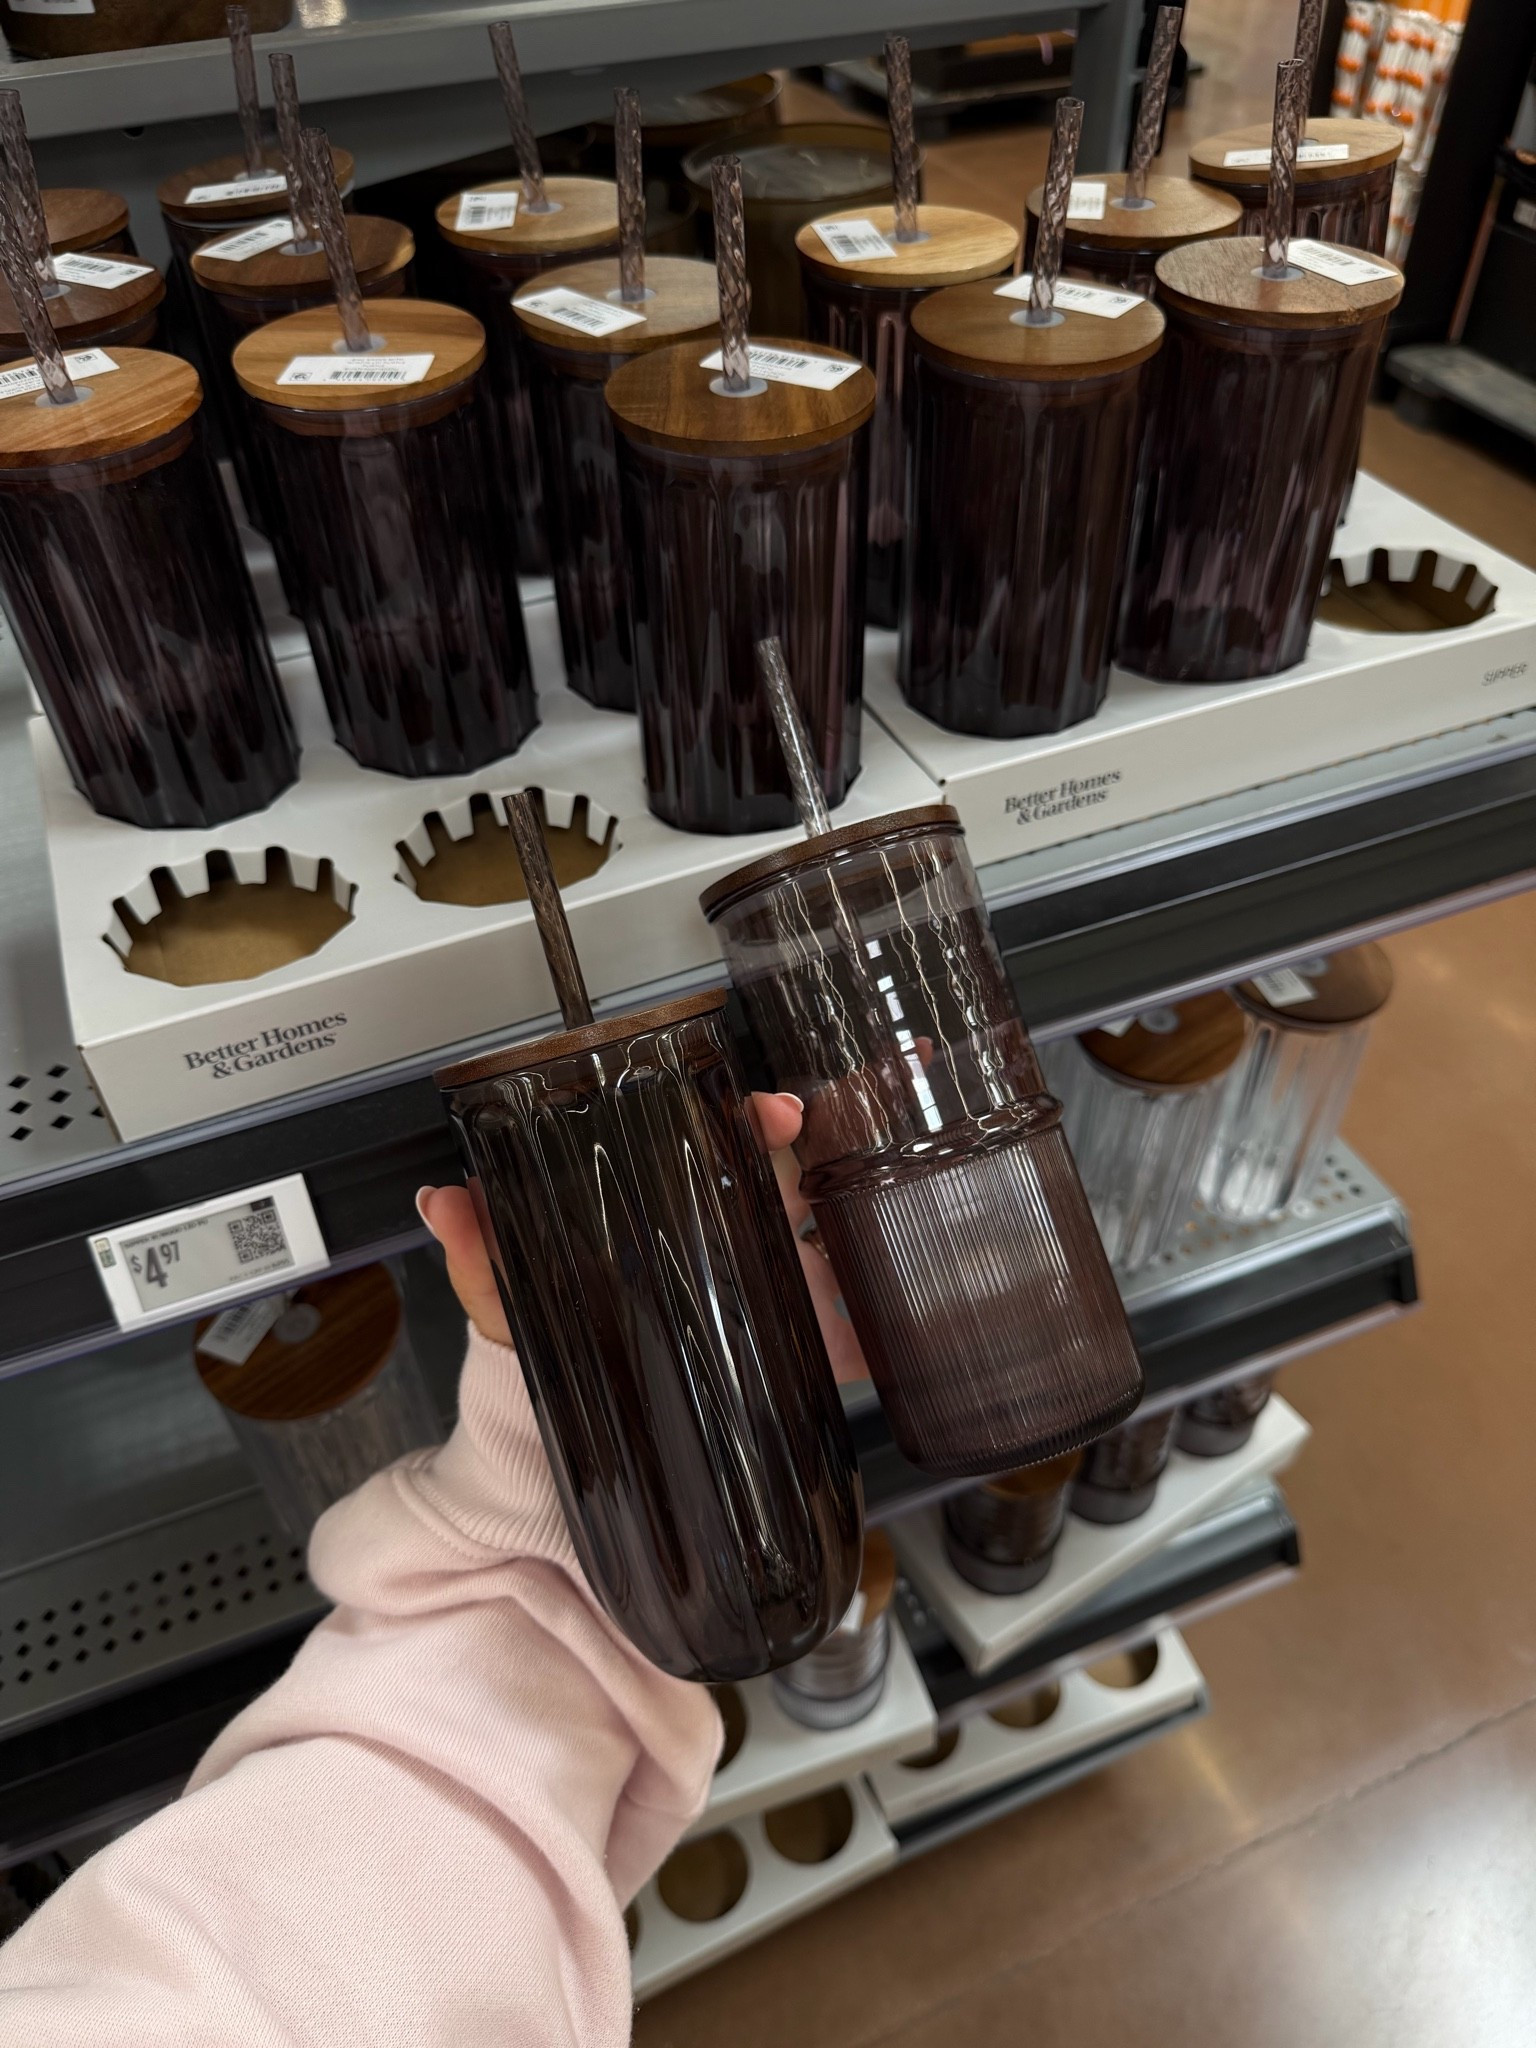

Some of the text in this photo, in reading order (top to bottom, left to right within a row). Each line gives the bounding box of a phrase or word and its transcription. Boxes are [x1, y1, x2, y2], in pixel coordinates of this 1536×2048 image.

[1004, 771, 1121, 813] Better Homes
[1033, 790, 1108, 820] Gardens
[184, 1012, 348, 1070] Better Homes
[234, 1033, 336, 1072] Gardens
